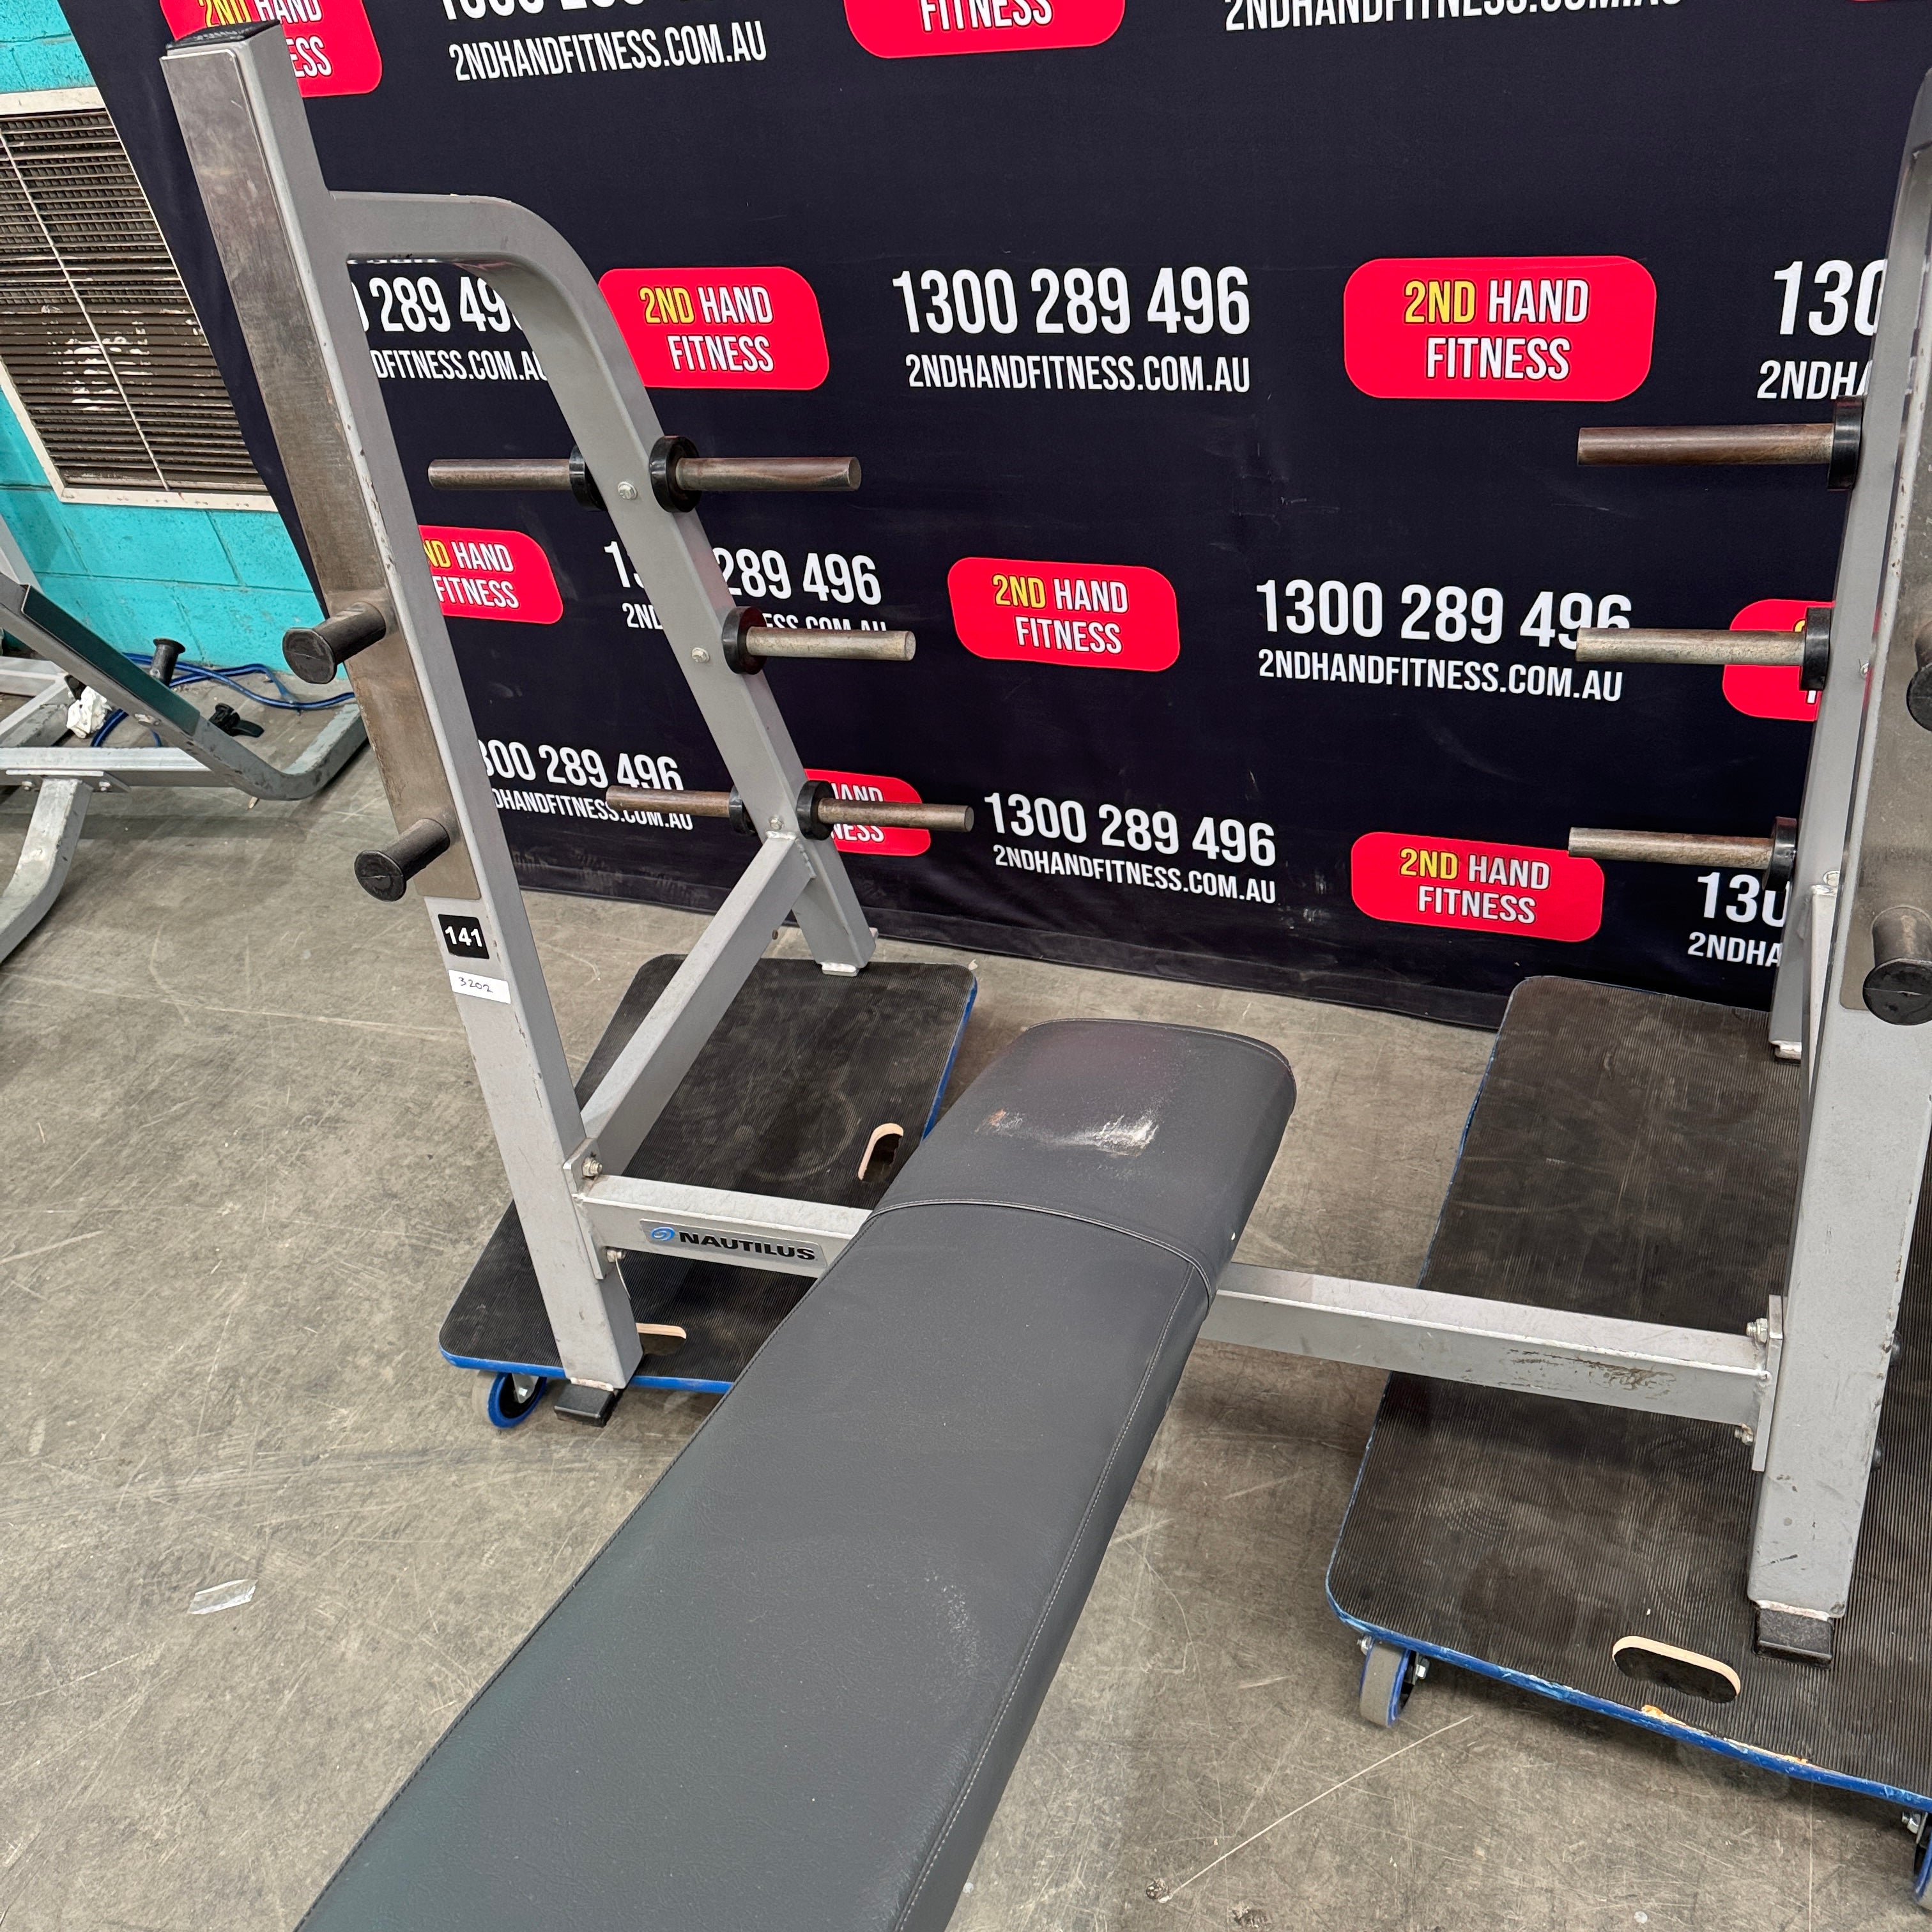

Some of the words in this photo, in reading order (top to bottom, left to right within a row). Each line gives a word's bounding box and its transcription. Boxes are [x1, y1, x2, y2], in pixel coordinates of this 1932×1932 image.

[448, 20, 767, 81] 2NDHANDFITNESS.COM.AU
[369, 277, 451, 332] 289
[459, 277, 524, 332] 49
[639, 287, 695, 323] 2ND
[697, 286, 774, 324] HAND
[892, 269, 1018, 334] 1300
[1030, 268, 1131, 334] 289
[1147, 266, 1250, 334] 496
[1404, 280, 1476, 323] 2ND
[1489, 279, 1589, 323] HAND
[1774, 259, 1888, 337] 130
[666, 335, 774, 372] FITNESS
[905, 354, 1250, 393] 2NDHANDFITNESS.COM.AU
[1426, 337, 1570, 380] FITNESS
[424, 540, 452, 568] ND
[450, 540, 514, 572] HAND
[712, 547, 792, 599] 289
[802, 552, 882, 606] 496
[432, 575, 519, 609] FITNESS
[992, 574, 1046, 608] 2ND
[1054, 578, 1128, 613] HAND
[1015, 616, 1123, 654] FITNESS
[1256, 579, 1383, 638] 1300
[1400, 584, 1504, 645] 289
[1519, 590, 1632, 650] 496
[1257, 648, 1623, 702] 2NDHANDFITNESS.COM.AU
[538, 744, 608, 788] 289
[617, 753, 684, 791] 496
[830, 823, 885, 843] NESS
[984, 792, 1087, 843] 1300
[1098, 804, 1179, 855] 289
[1192, 816, 1276, 867] 496
[993, 844, 1276, 904] 2NDHANDFITNESS.COM.AU
[1400, 848, 1459, 880] 2ND
[1468, 854, 1550, 890] HAND
[1418, 885, 1538, 924] FITNESS
[1697, 871, 1790, 927] 130
[445, 926, 483, 947] 141
[458, 976, 494, 993] 3202
[679, 1230, 816, 1261] NAUTILUS
